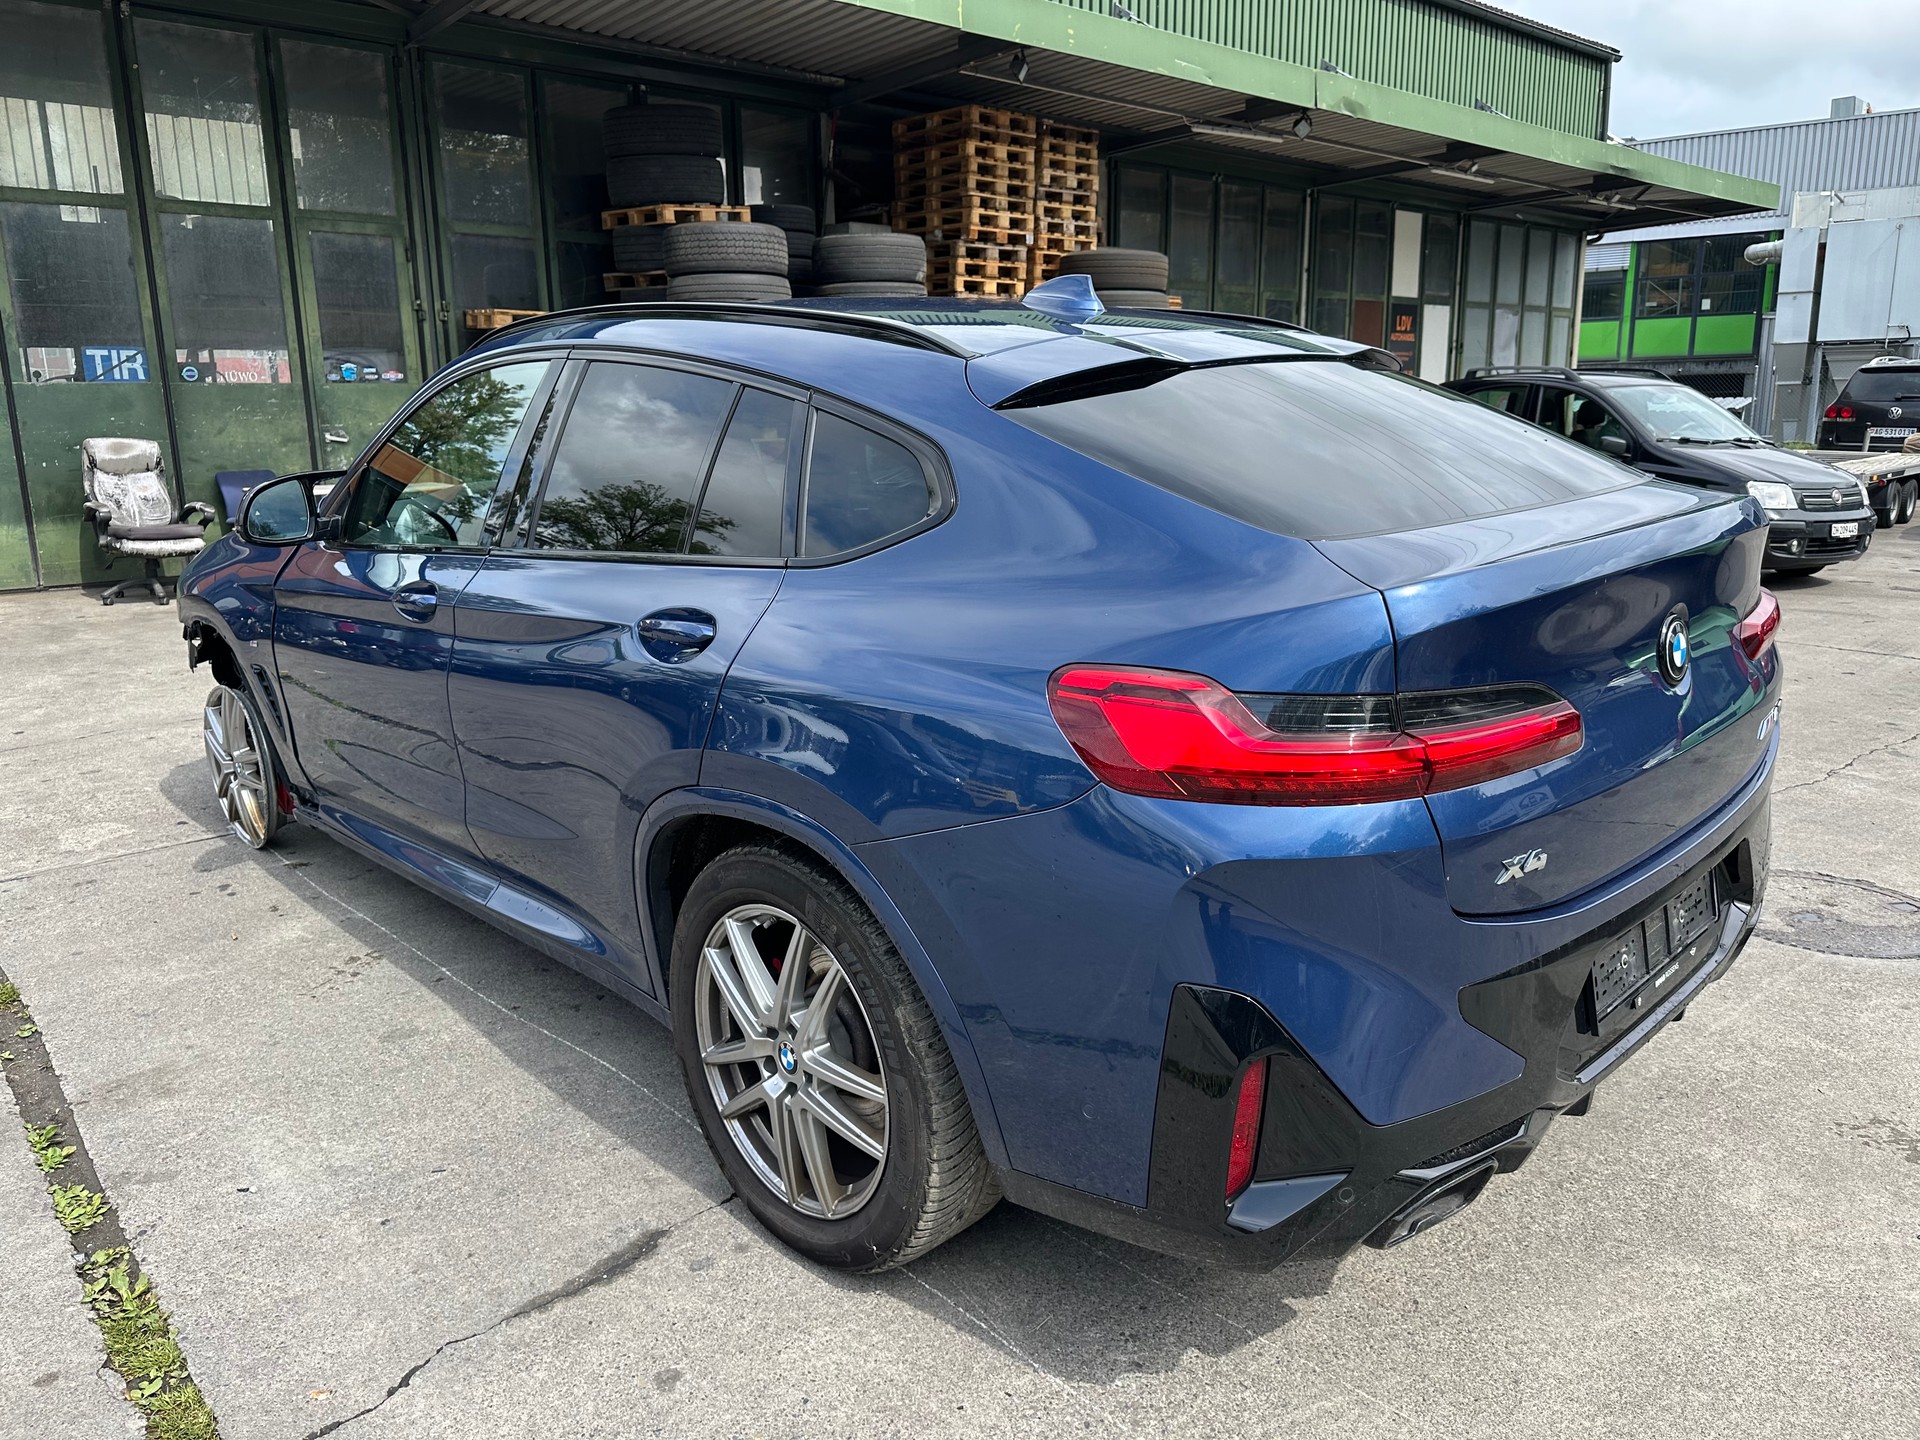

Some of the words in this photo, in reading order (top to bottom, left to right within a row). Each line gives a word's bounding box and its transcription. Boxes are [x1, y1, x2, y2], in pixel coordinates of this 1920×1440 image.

[1396, 315, 1412, 331] LDV
[86, 349, 146, 380] TIR
[1874, 428, 1884, 436] AG
[1884, 428, 1911, 437] 531013
[1494, 848, 1548, 885] X4
[837, 941, 901, 1068] MICHELIN
